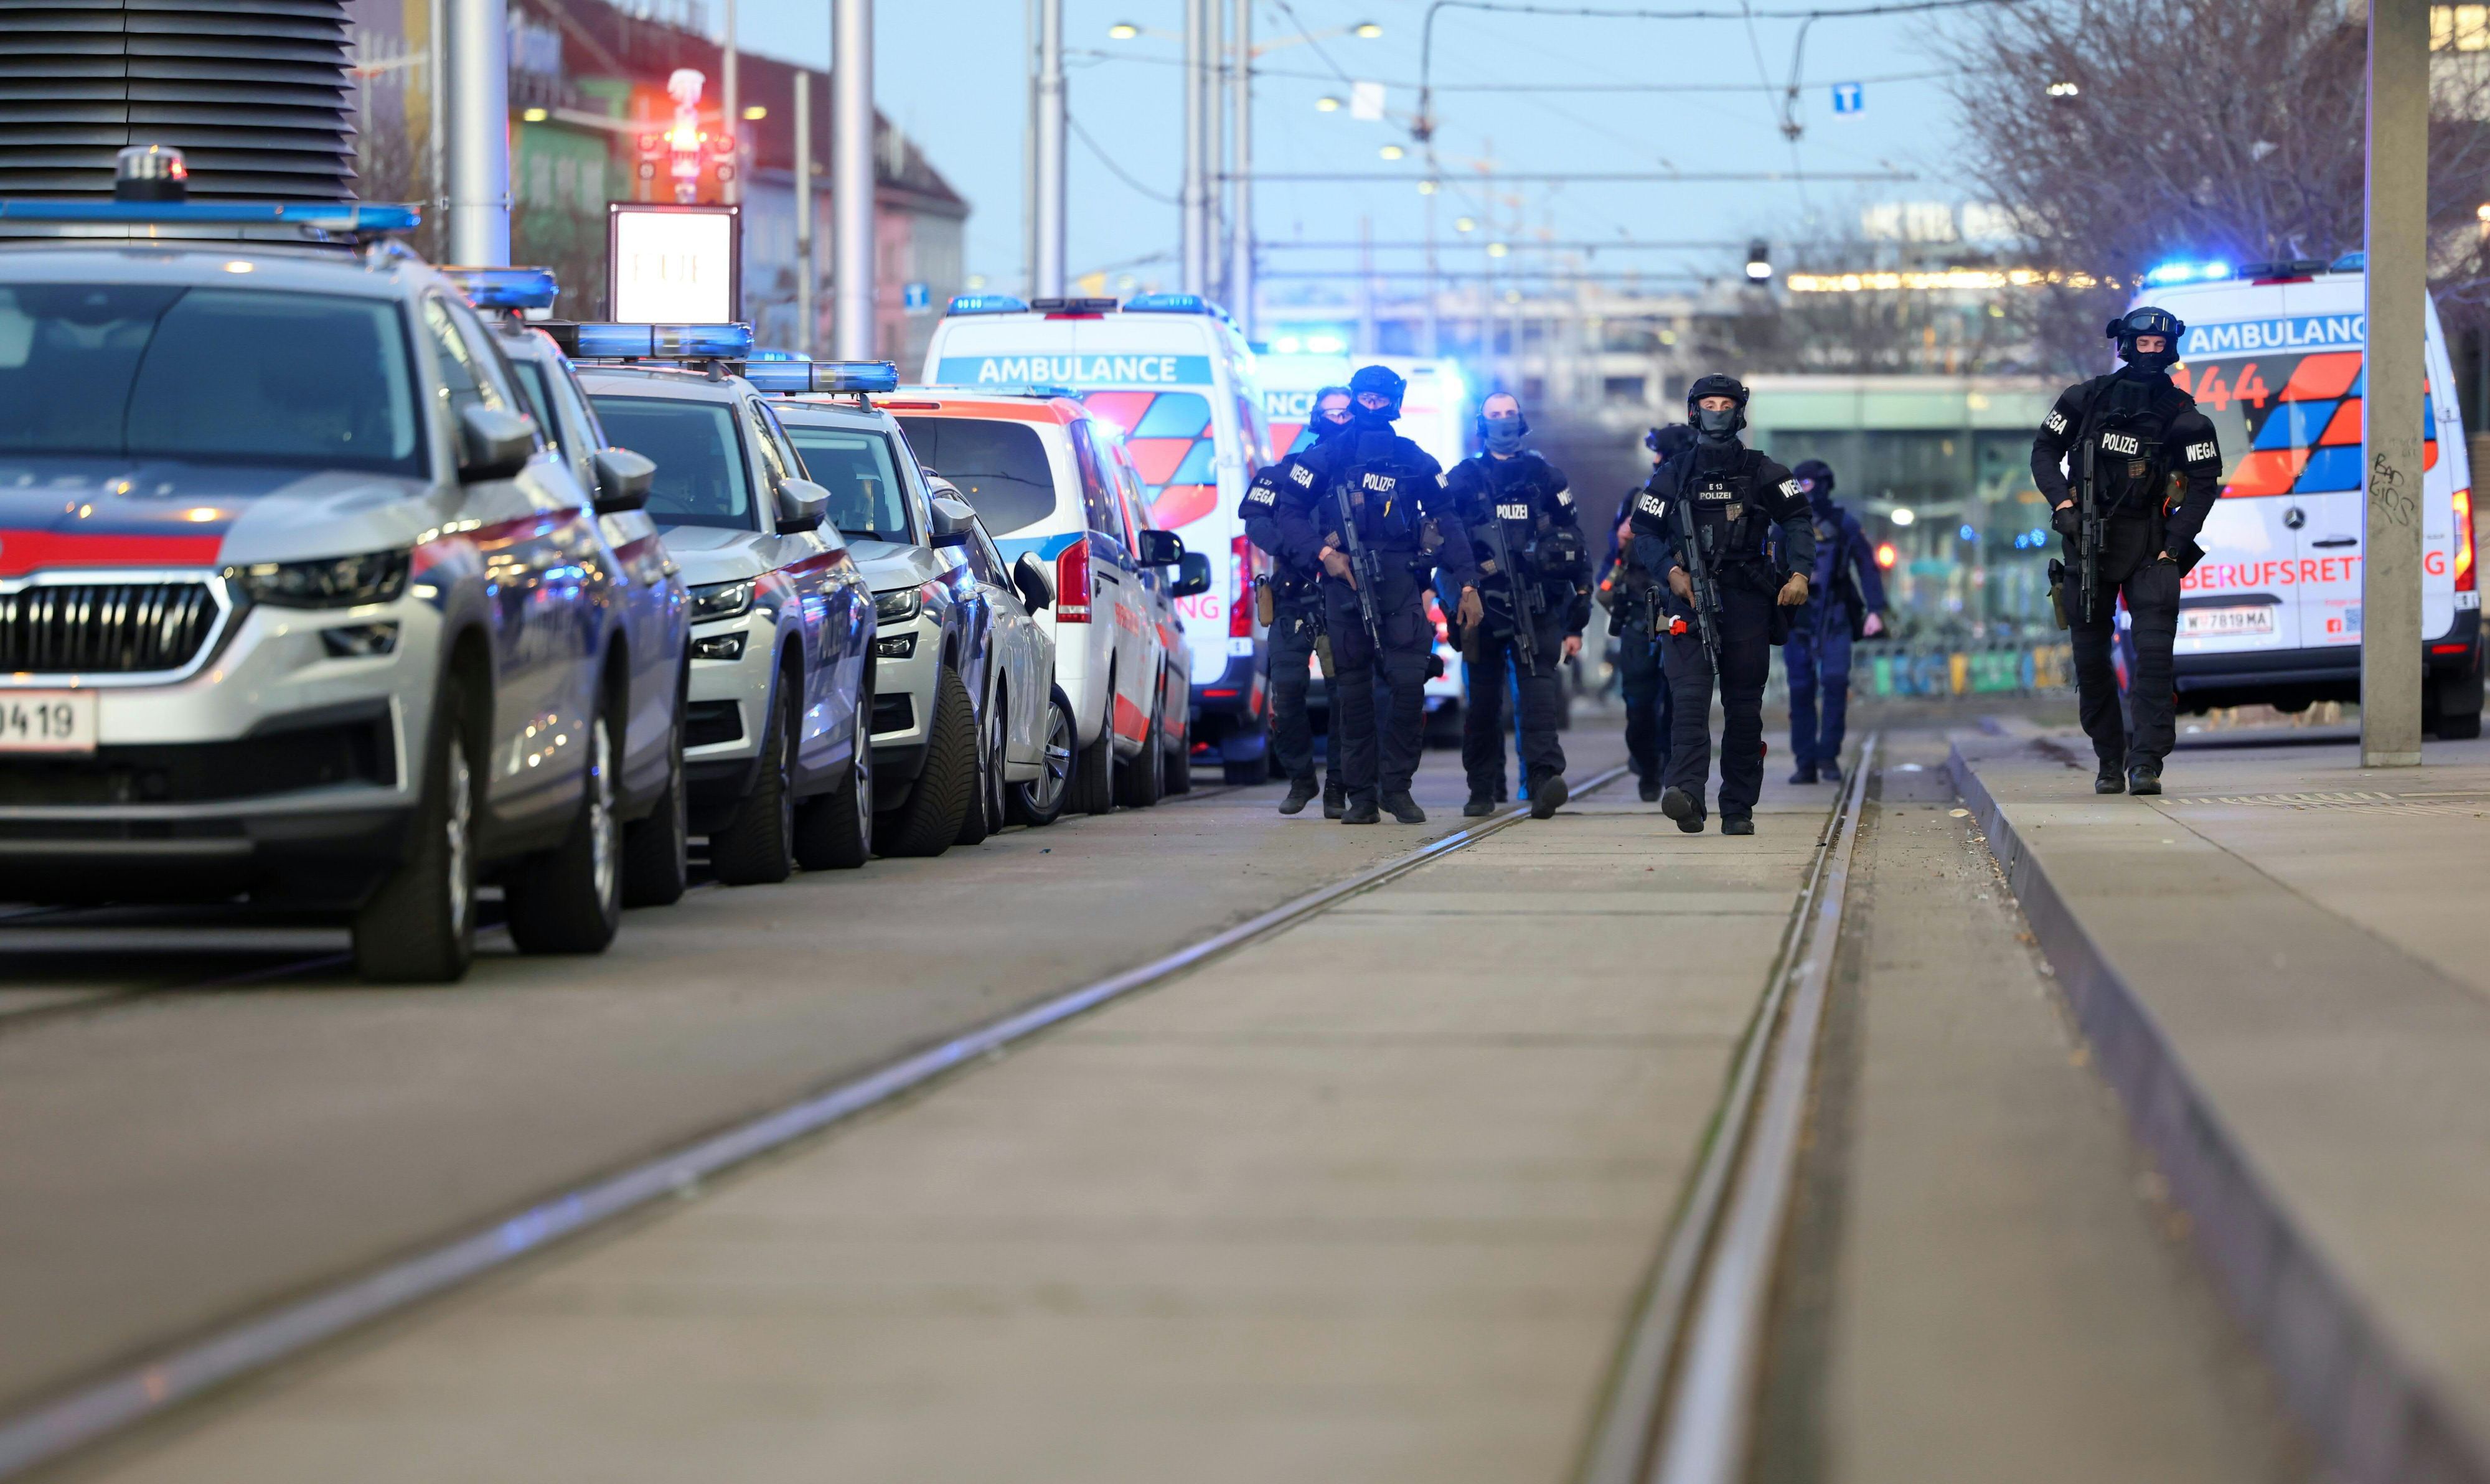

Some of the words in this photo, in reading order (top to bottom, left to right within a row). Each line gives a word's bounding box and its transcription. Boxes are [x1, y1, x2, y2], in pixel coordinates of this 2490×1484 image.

[2188, 316, 2364, 353] AMBULANC
[979, 356, 1177, 383] AMBULANCE
[2102, 433, 2138, 455] POLIZEI
[2186, 441, 2217, 462] WEGA
[1290, 463, 1313, 489] WEGA
[1248, 487, 1276, 506] WEGA
[1638, 493, 1665, 517] WEGA
[1700, 492, 1731, 500] POLIZEI
[1496, 504, 1528, 519] POLIZEI
[0, 702, 73, 739] 419
